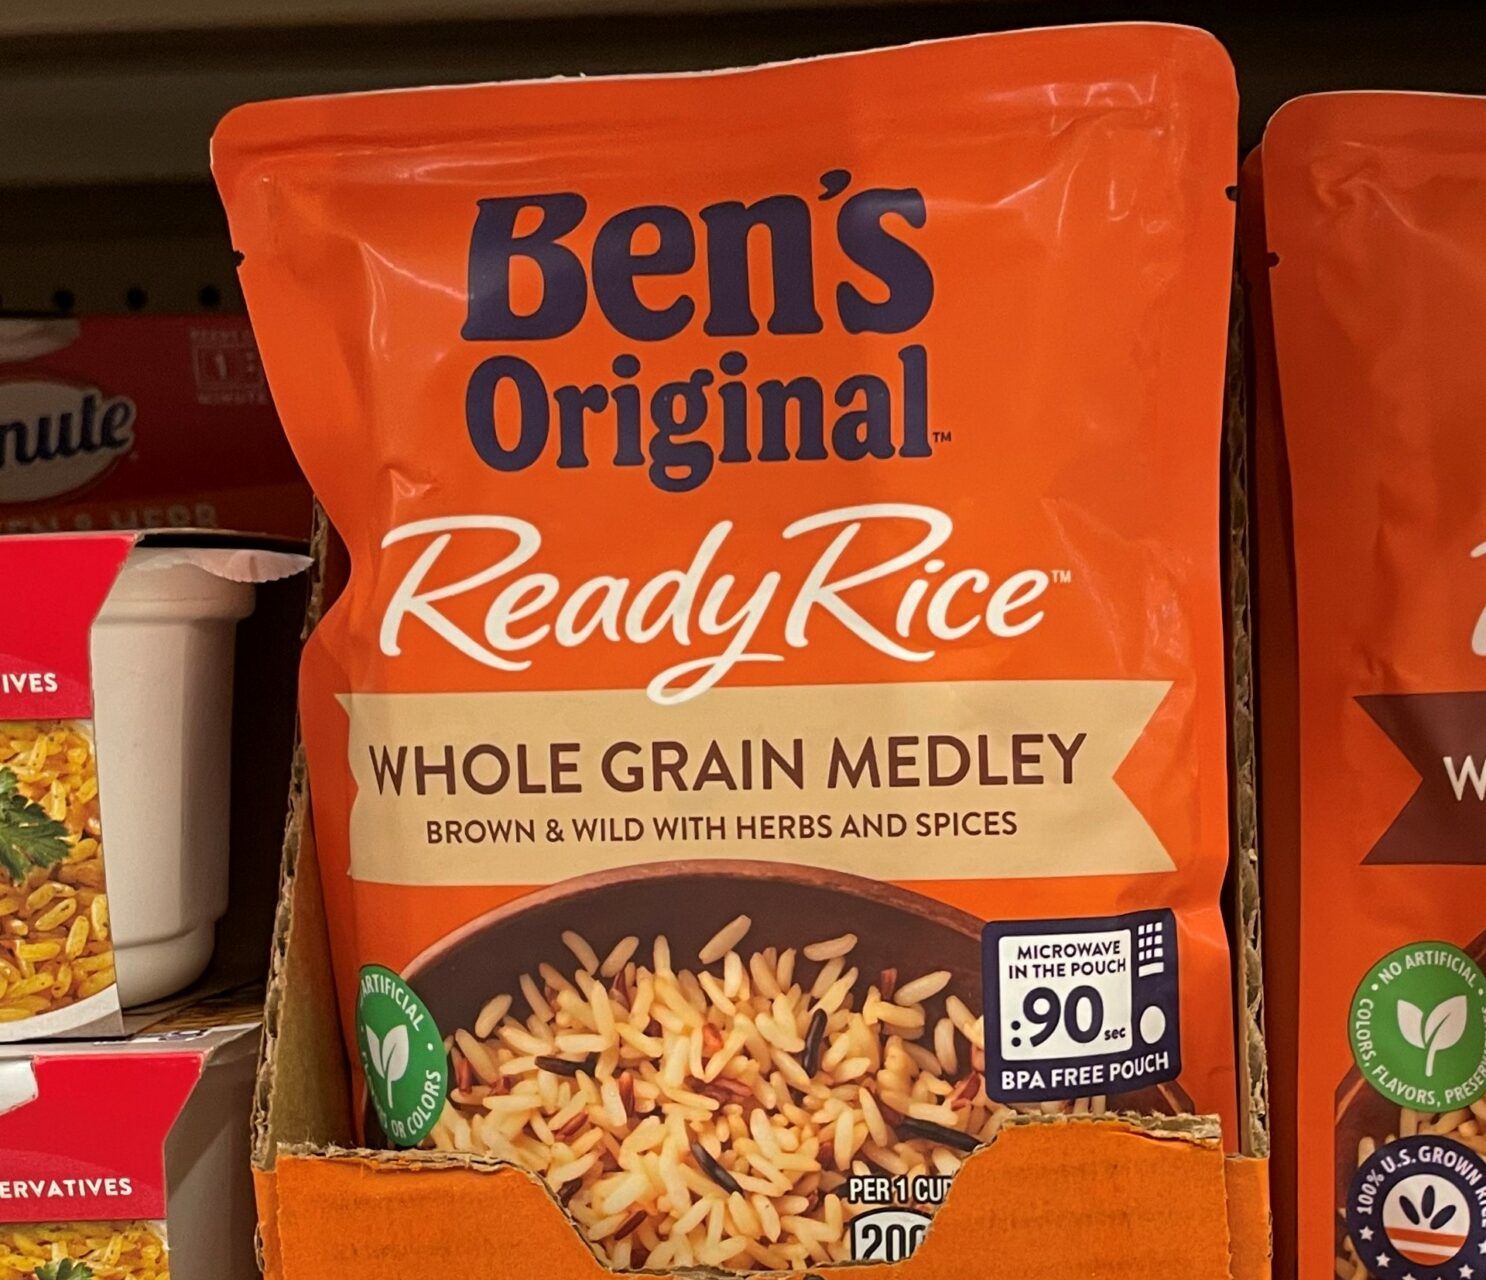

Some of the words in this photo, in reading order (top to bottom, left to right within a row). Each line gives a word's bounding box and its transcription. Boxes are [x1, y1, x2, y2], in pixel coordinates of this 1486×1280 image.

[461, 168, 935, 342] Ben's
[465, 344, 932, 493] Original
[379, 515, 785, 705] Ready
[782, 503, 1050, 662] Rice
[2, 672, 58, 694] IVES
[369, 743, 583, 797] WHOLE
[601, 738, 804, 793] GRAIN
[827, 732, 1087, 789] MEDLEY
[426, 817, 536, 845] BROWN
[545, 818, 565, 843] &
[572, 816, 644, 842] WILD
[652, 814, 730, 842] WITH
[736, 813, 832, 840] HERBS
[840, 811, 907, 838] AND
[916, 811, 1018, 837] SPICES
[1017, 940, 1121, 961] MICROWAVE
[1071, 958, 1127, 977] POUCH
[1009, 965, 1028, 979] IN
[1033, 963, 1066, 978] THE
[1378, 961, 1402, 985] NO
[1405, 950, 1478, 988] ARTIFICIAL
[361, 973, 425, 1032] ARTIFICIAL
[1104, 1027, 1126, 1041] sec
[1001, 1070, 1046, 1091] BPA
[1051, 1064, 1104, 1088] FREE
[1110, 1051, 1170, 1082] POUCH
[407, 1069, 441, 1135] COLORS
[0, 1178, 133, 1199] ERVATIVES
[849, 1178, 890, 1201] PER
[896, 1178, 906, 1201] 1
[1356, 1169, 1385, 1216] 100%
[1380, 1148, 1416, 1174] U.S.
[1418, 1145, 1483, 1186] GROWN
